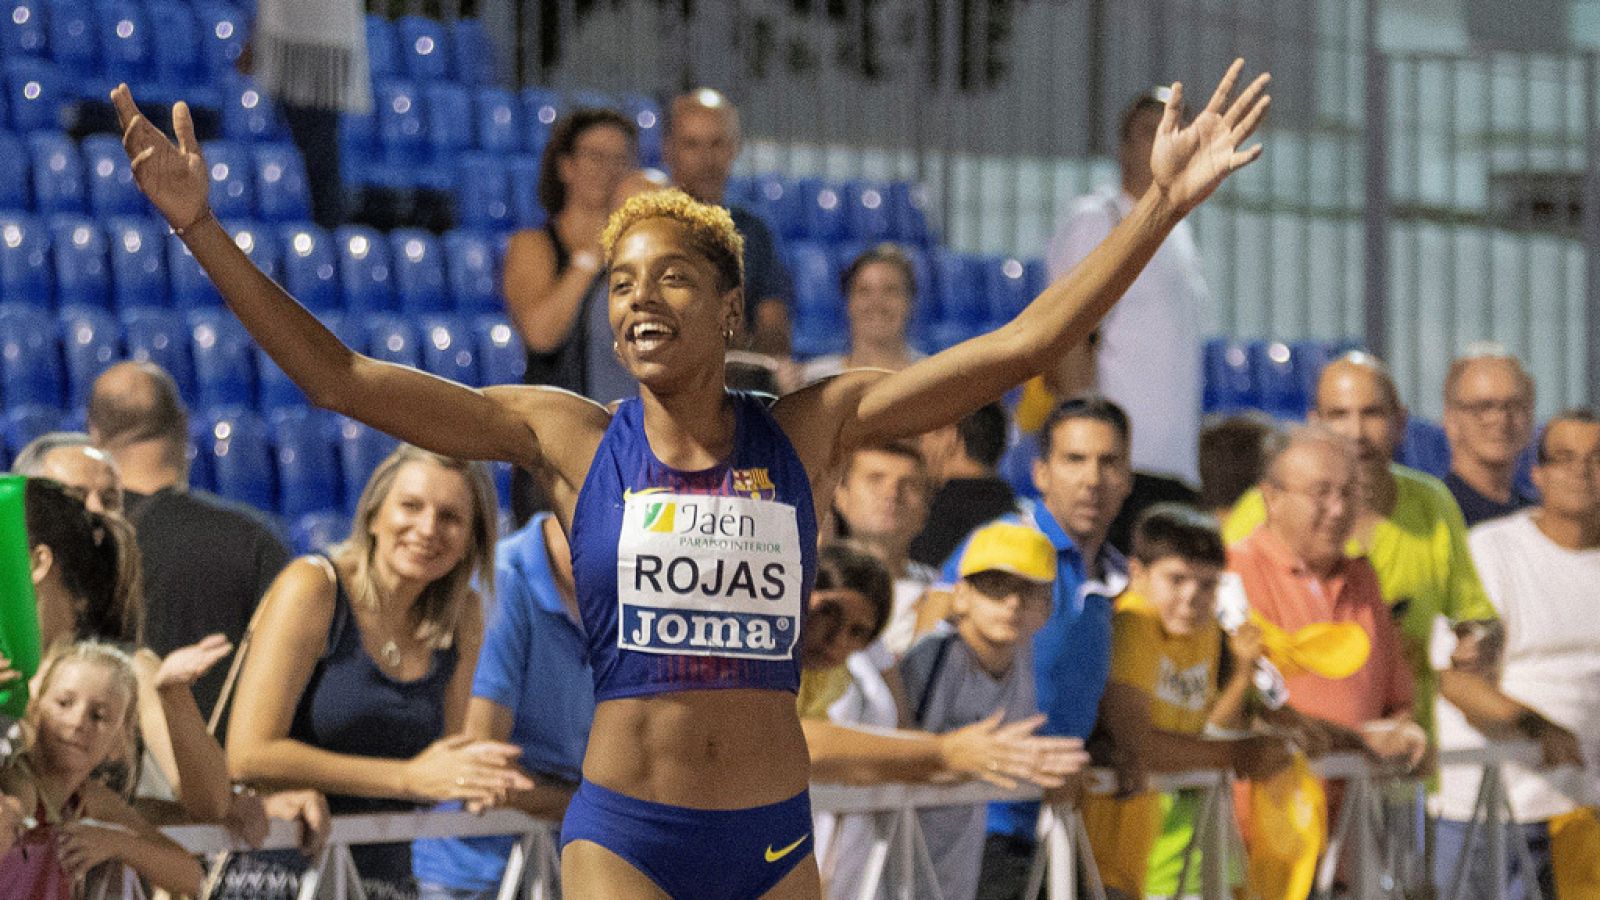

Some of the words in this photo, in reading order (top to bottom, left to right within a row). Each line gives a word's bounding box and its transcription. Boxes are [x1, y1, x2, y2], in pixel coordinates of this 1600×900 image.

[680, 504, 756, 537] Jaén
[731, 541, 782, 553] INTERIOR
[634, 554, 786, 601] ROJAS
